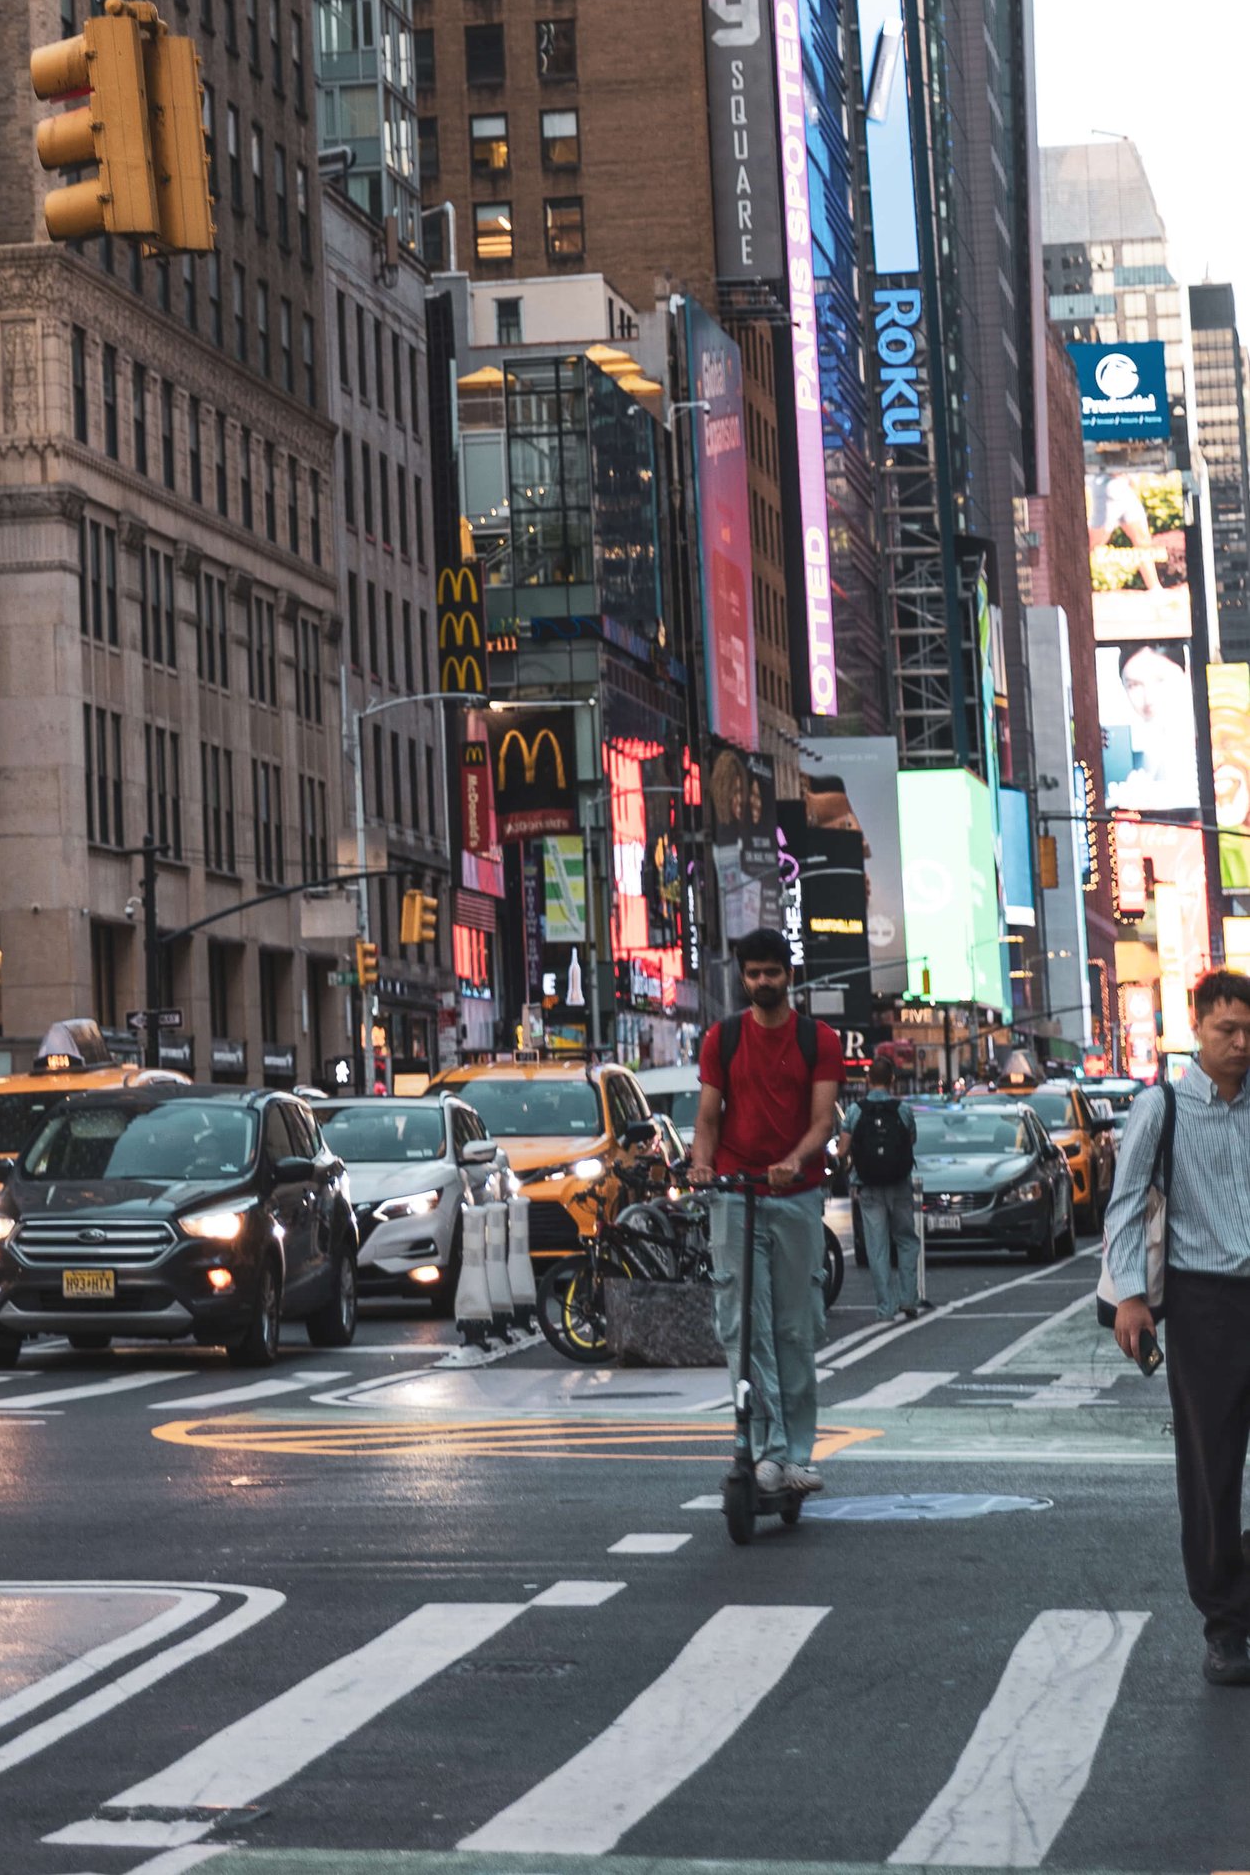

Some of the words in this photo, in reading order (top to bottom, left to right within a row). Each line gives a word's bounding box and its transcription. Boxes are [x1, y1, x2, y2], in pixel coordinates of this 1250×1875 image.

[729, 60, 754, 266] SQUARE
[776, 0, 809, 245] SPOTTED
[791, 256, 819, 413] PARIS
[873, 287, 923, 445] ROKU
